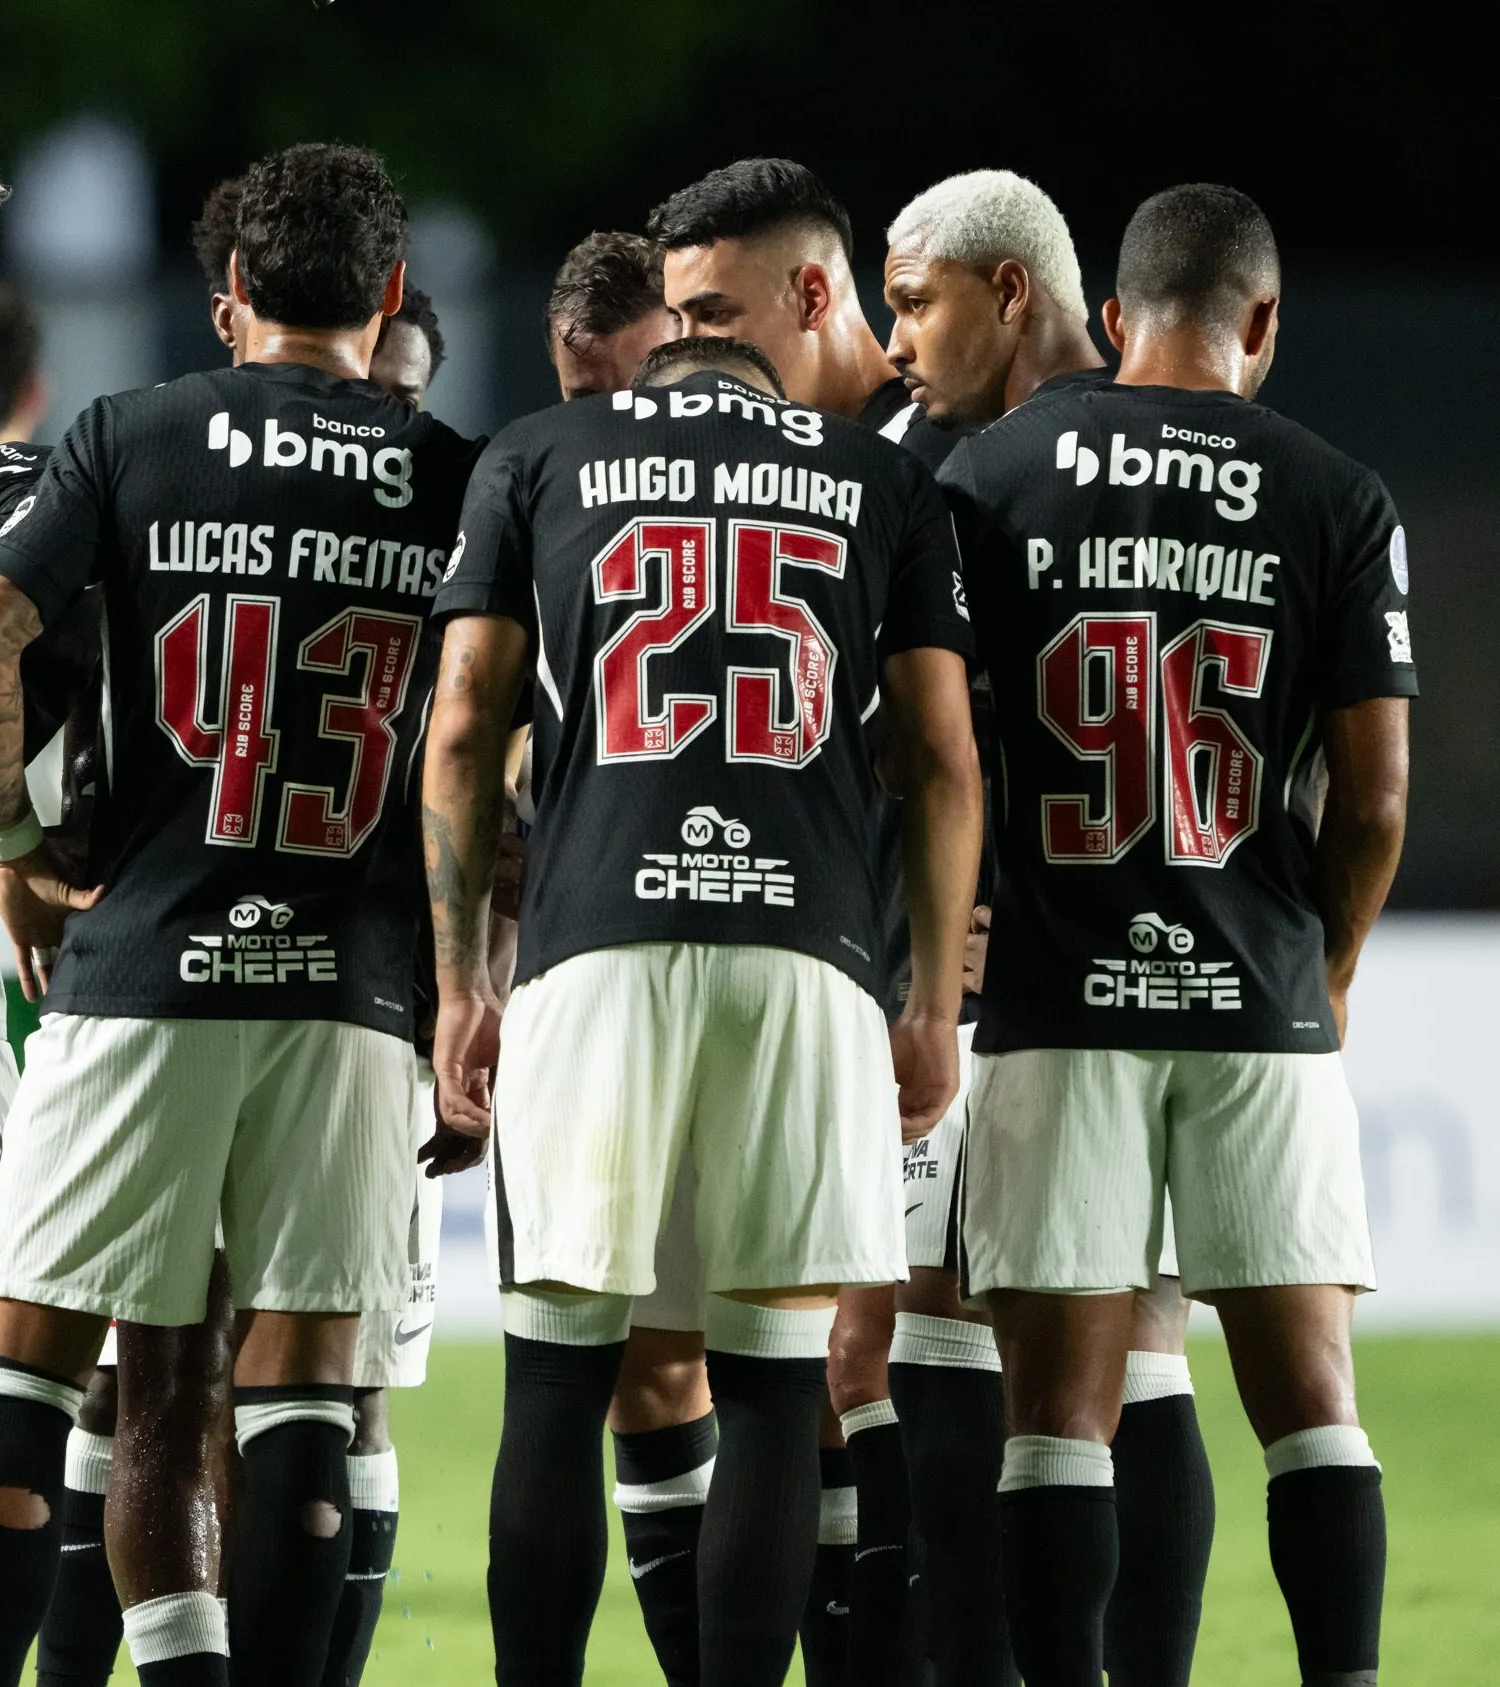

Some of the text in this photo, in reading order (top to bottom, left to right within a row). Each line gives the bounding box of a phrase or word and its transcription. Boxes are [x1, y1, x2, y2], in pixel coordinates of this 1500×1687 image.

[313, 412, 386, 438] banco
[668, 390, 825, 448] bmg
[1161, 423, 1237, 450] banco
[263, 418, 414, 509] bmg
[1108, 433, 1263, 522] bmg
[579, 456, 863, 528] HUGO MOURA
[149, 519, 445, 598] LUCAS FREITAS
[682, 539, 696, 584] SCORE
[1027, 536, 1281, 607] P. HENRIQUE
[381, 637, 401, 684] SCORE
[591, 515, 848, 771] 25
[1126, 635, 1139, 684] SCORE
[154, 592, 423, 860] 43
[238, 683, 255, 731] SCORE
[1036, 610, 1274, 869] 96
[1228, 749, 1244, 794] SCORE
[687, 823, 745, 843] M C
[681, 853, 750, 870] MOTO
[635, 868, 795, 907] CHEFE
[227, 934, 291, 950] MOTO
[1131, 931, 1189, 948] M C
[179, 949, 338, 984] CHEFE
[1130, 959, 1196, 976] MOTO
[1084, 973, 1243, 1010] CHEFE
